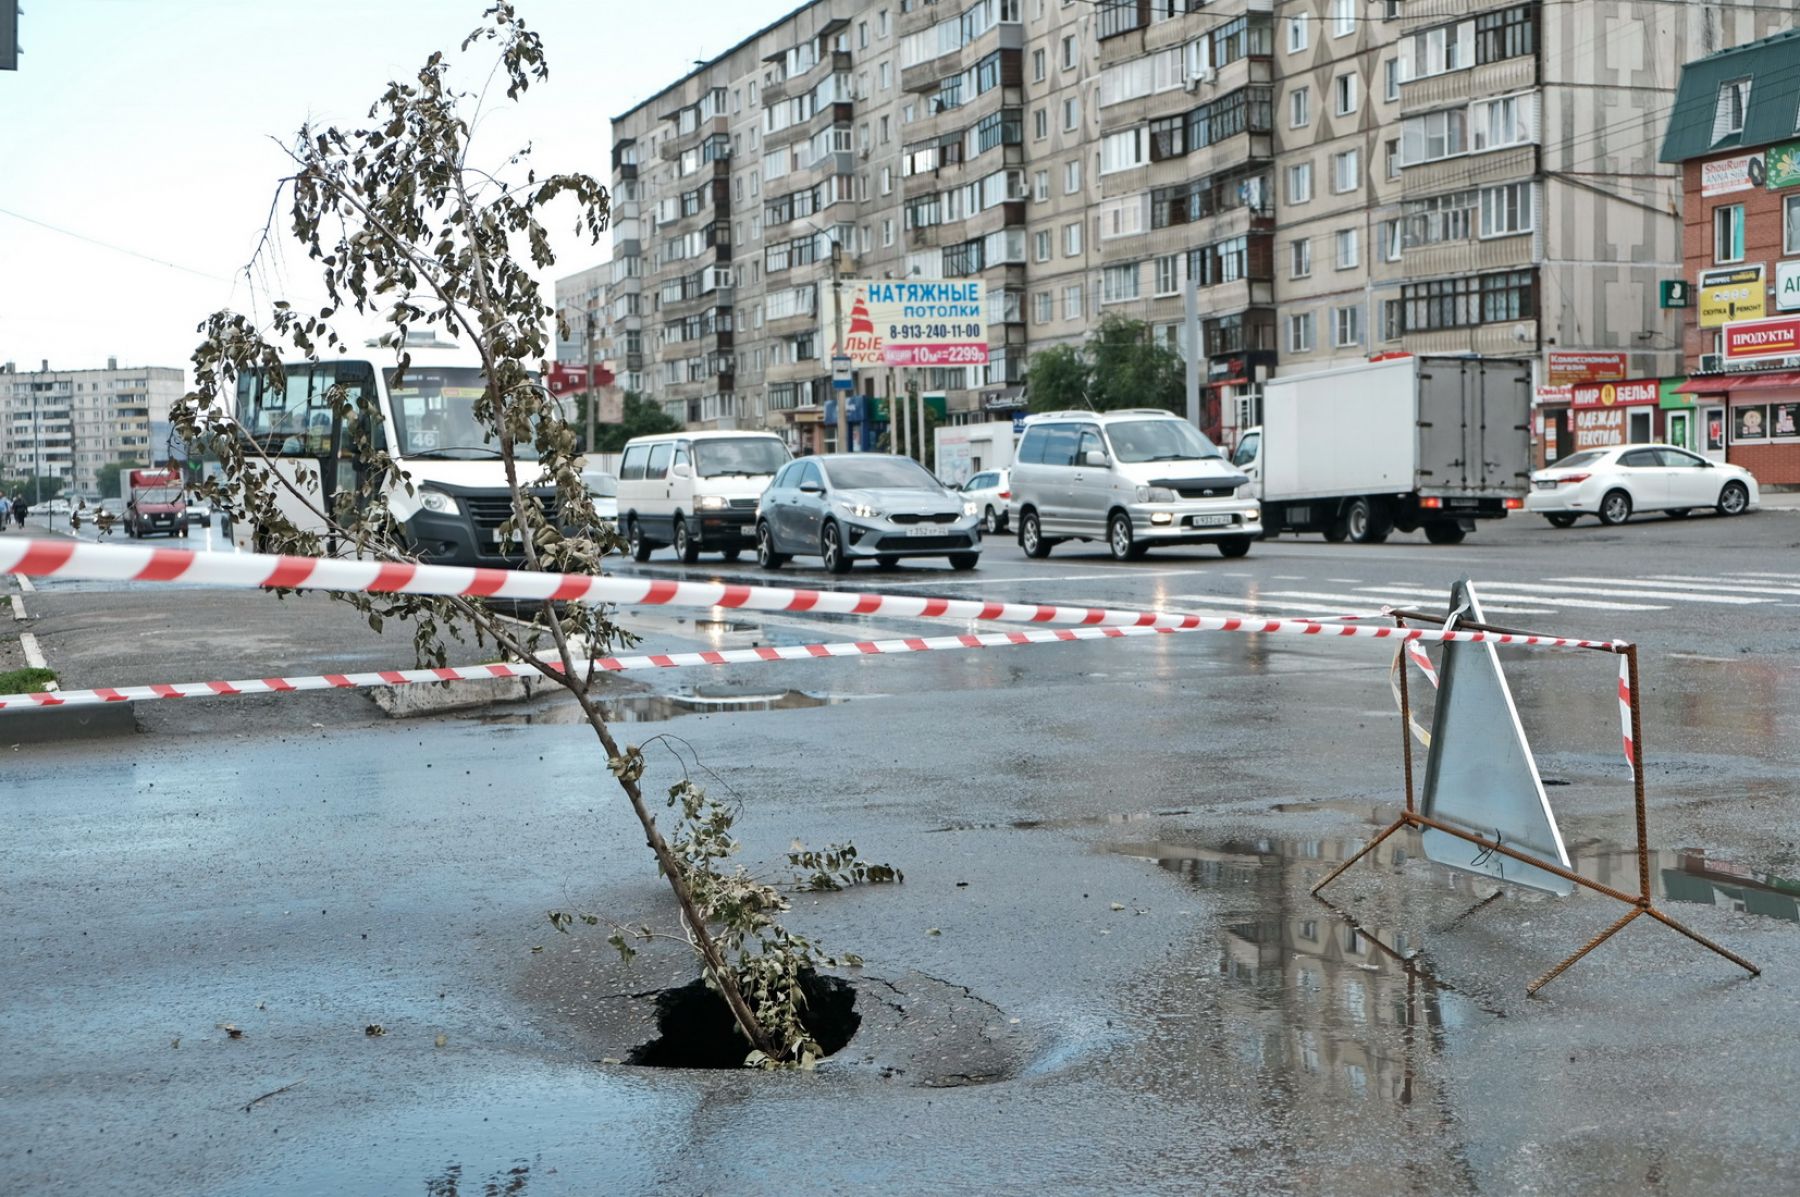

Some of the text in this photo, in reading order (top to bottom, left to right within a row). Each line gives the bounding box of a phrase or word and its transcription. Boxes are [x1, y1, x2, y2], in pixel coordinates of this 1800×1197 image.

[868, 283, 979, 303] НАТЯЖНЫЕ
[1784, 275, 1800, 294] А
[903, 305, 980, 318] ПОТОЛКИ
[1703, 303, 1761, 316] СКУПКА РЕМОНТ
[890, 323, 980, 339] 8-913-240-11-00
[1732, 329, 1795, 346] ПРОДУКТЫ
[1574, 387, 1600, 404] МИР
[1616, 384, 1656, 402] БЕЛЬЯ
[1577, 410, 1622, 429] ОДЕЖДА
[412, 433, 436, 447] 46
[1577, 429, 1622, 446] ТЕКСТИЛЬ
